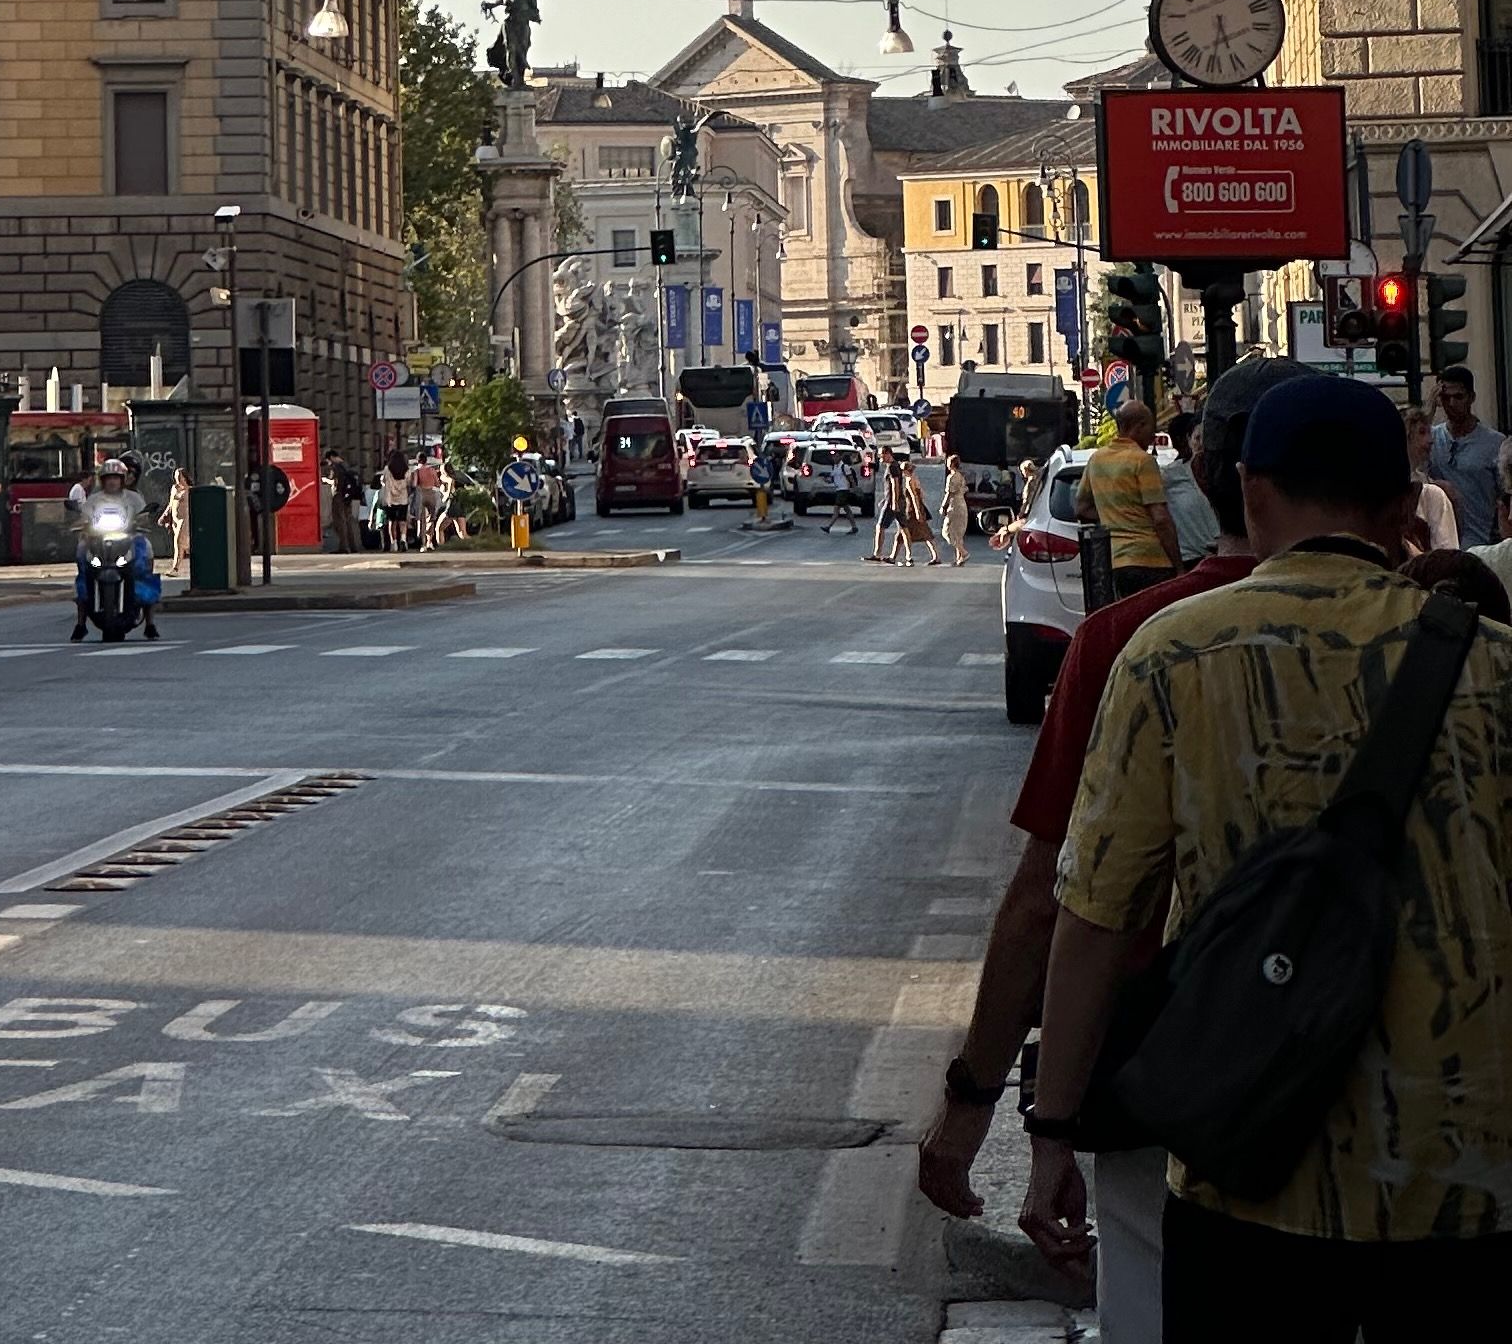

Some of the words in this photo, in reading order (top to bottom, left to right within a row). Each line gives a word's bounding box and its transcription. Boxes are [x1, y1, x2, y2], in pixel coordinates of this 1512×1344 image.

[1151, 107, 1303, 135] RIVOLTA
[1152, 140, 1240, 151] IMMOBILIARE
[1244, 140, 1268, 151] DAL
[1273, 139, 1305, 151] 1956
[1182, 182, 1214, 202] 800
[1219, 182, 1250, 202] 600
[1255, 181, 1287, 202] 600
[619, 436, 631, 449] 34
